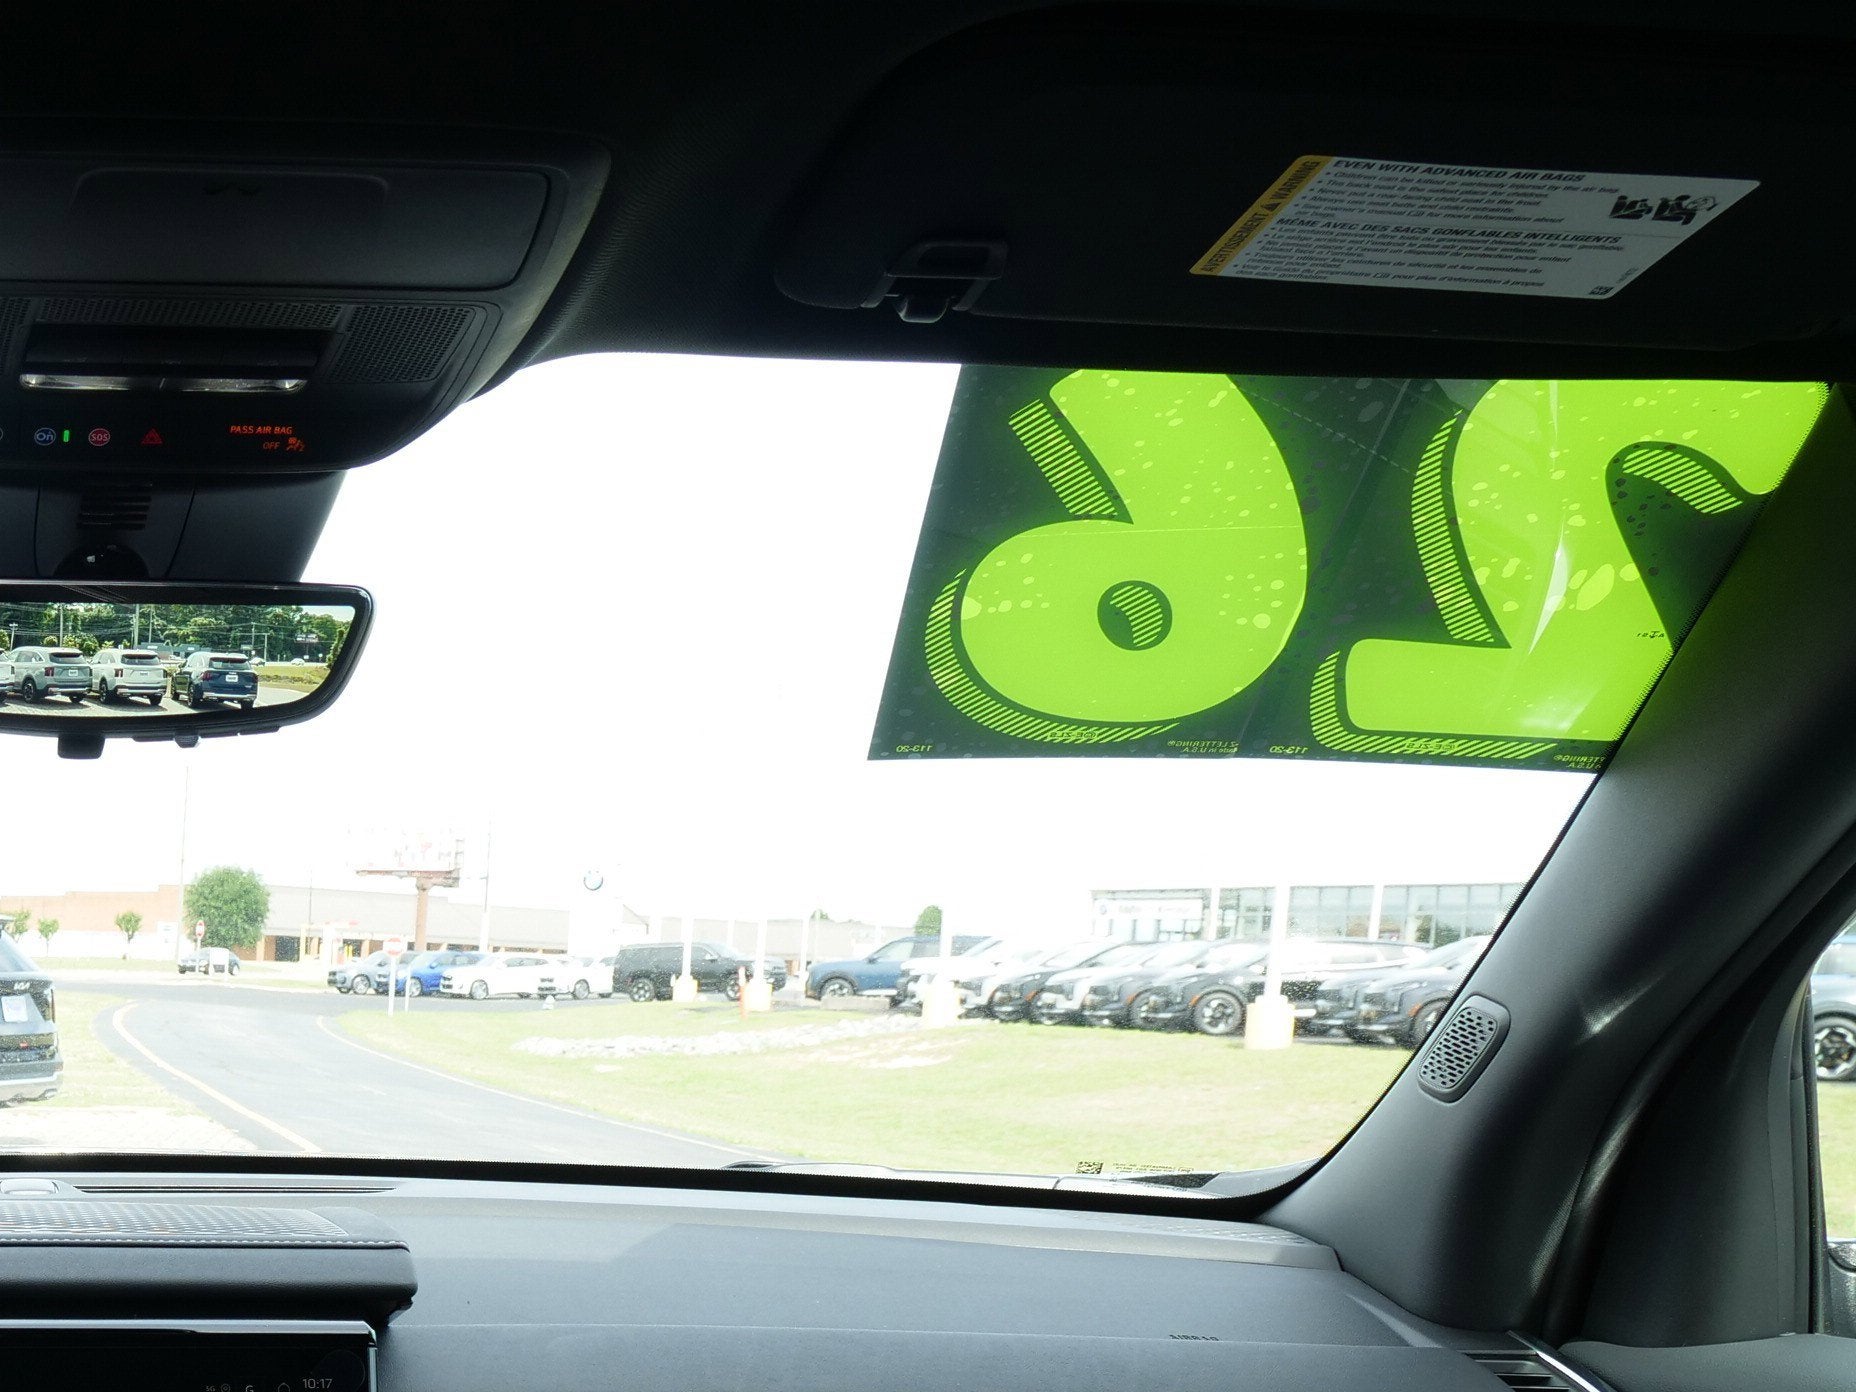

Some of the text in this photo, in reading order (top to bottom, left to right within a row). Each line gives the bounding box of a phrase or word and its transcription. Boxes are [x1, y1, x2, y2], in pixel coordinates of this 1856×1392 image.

[1333, 160, 1586, 182] EVEN WITH ADVANCED AIR BAGS
[1273, 160, 1322, 203] WARNING
[1323, 219, 1360, 230] AVEC
[1363, 223, 1391, 233] DES
[1393, 224, 1430, 235] SACS
[1524, 230, 1622, 244] INTELLIGENTS
[230, 425, 293, 435] PASS AIR BAG
[91, 432, 108, 442] SOS
[262, 442, 280, 450] OFF
[205, 1385, 216, 1392] 5G
[302, 1378, 332, 1389] 10:17
